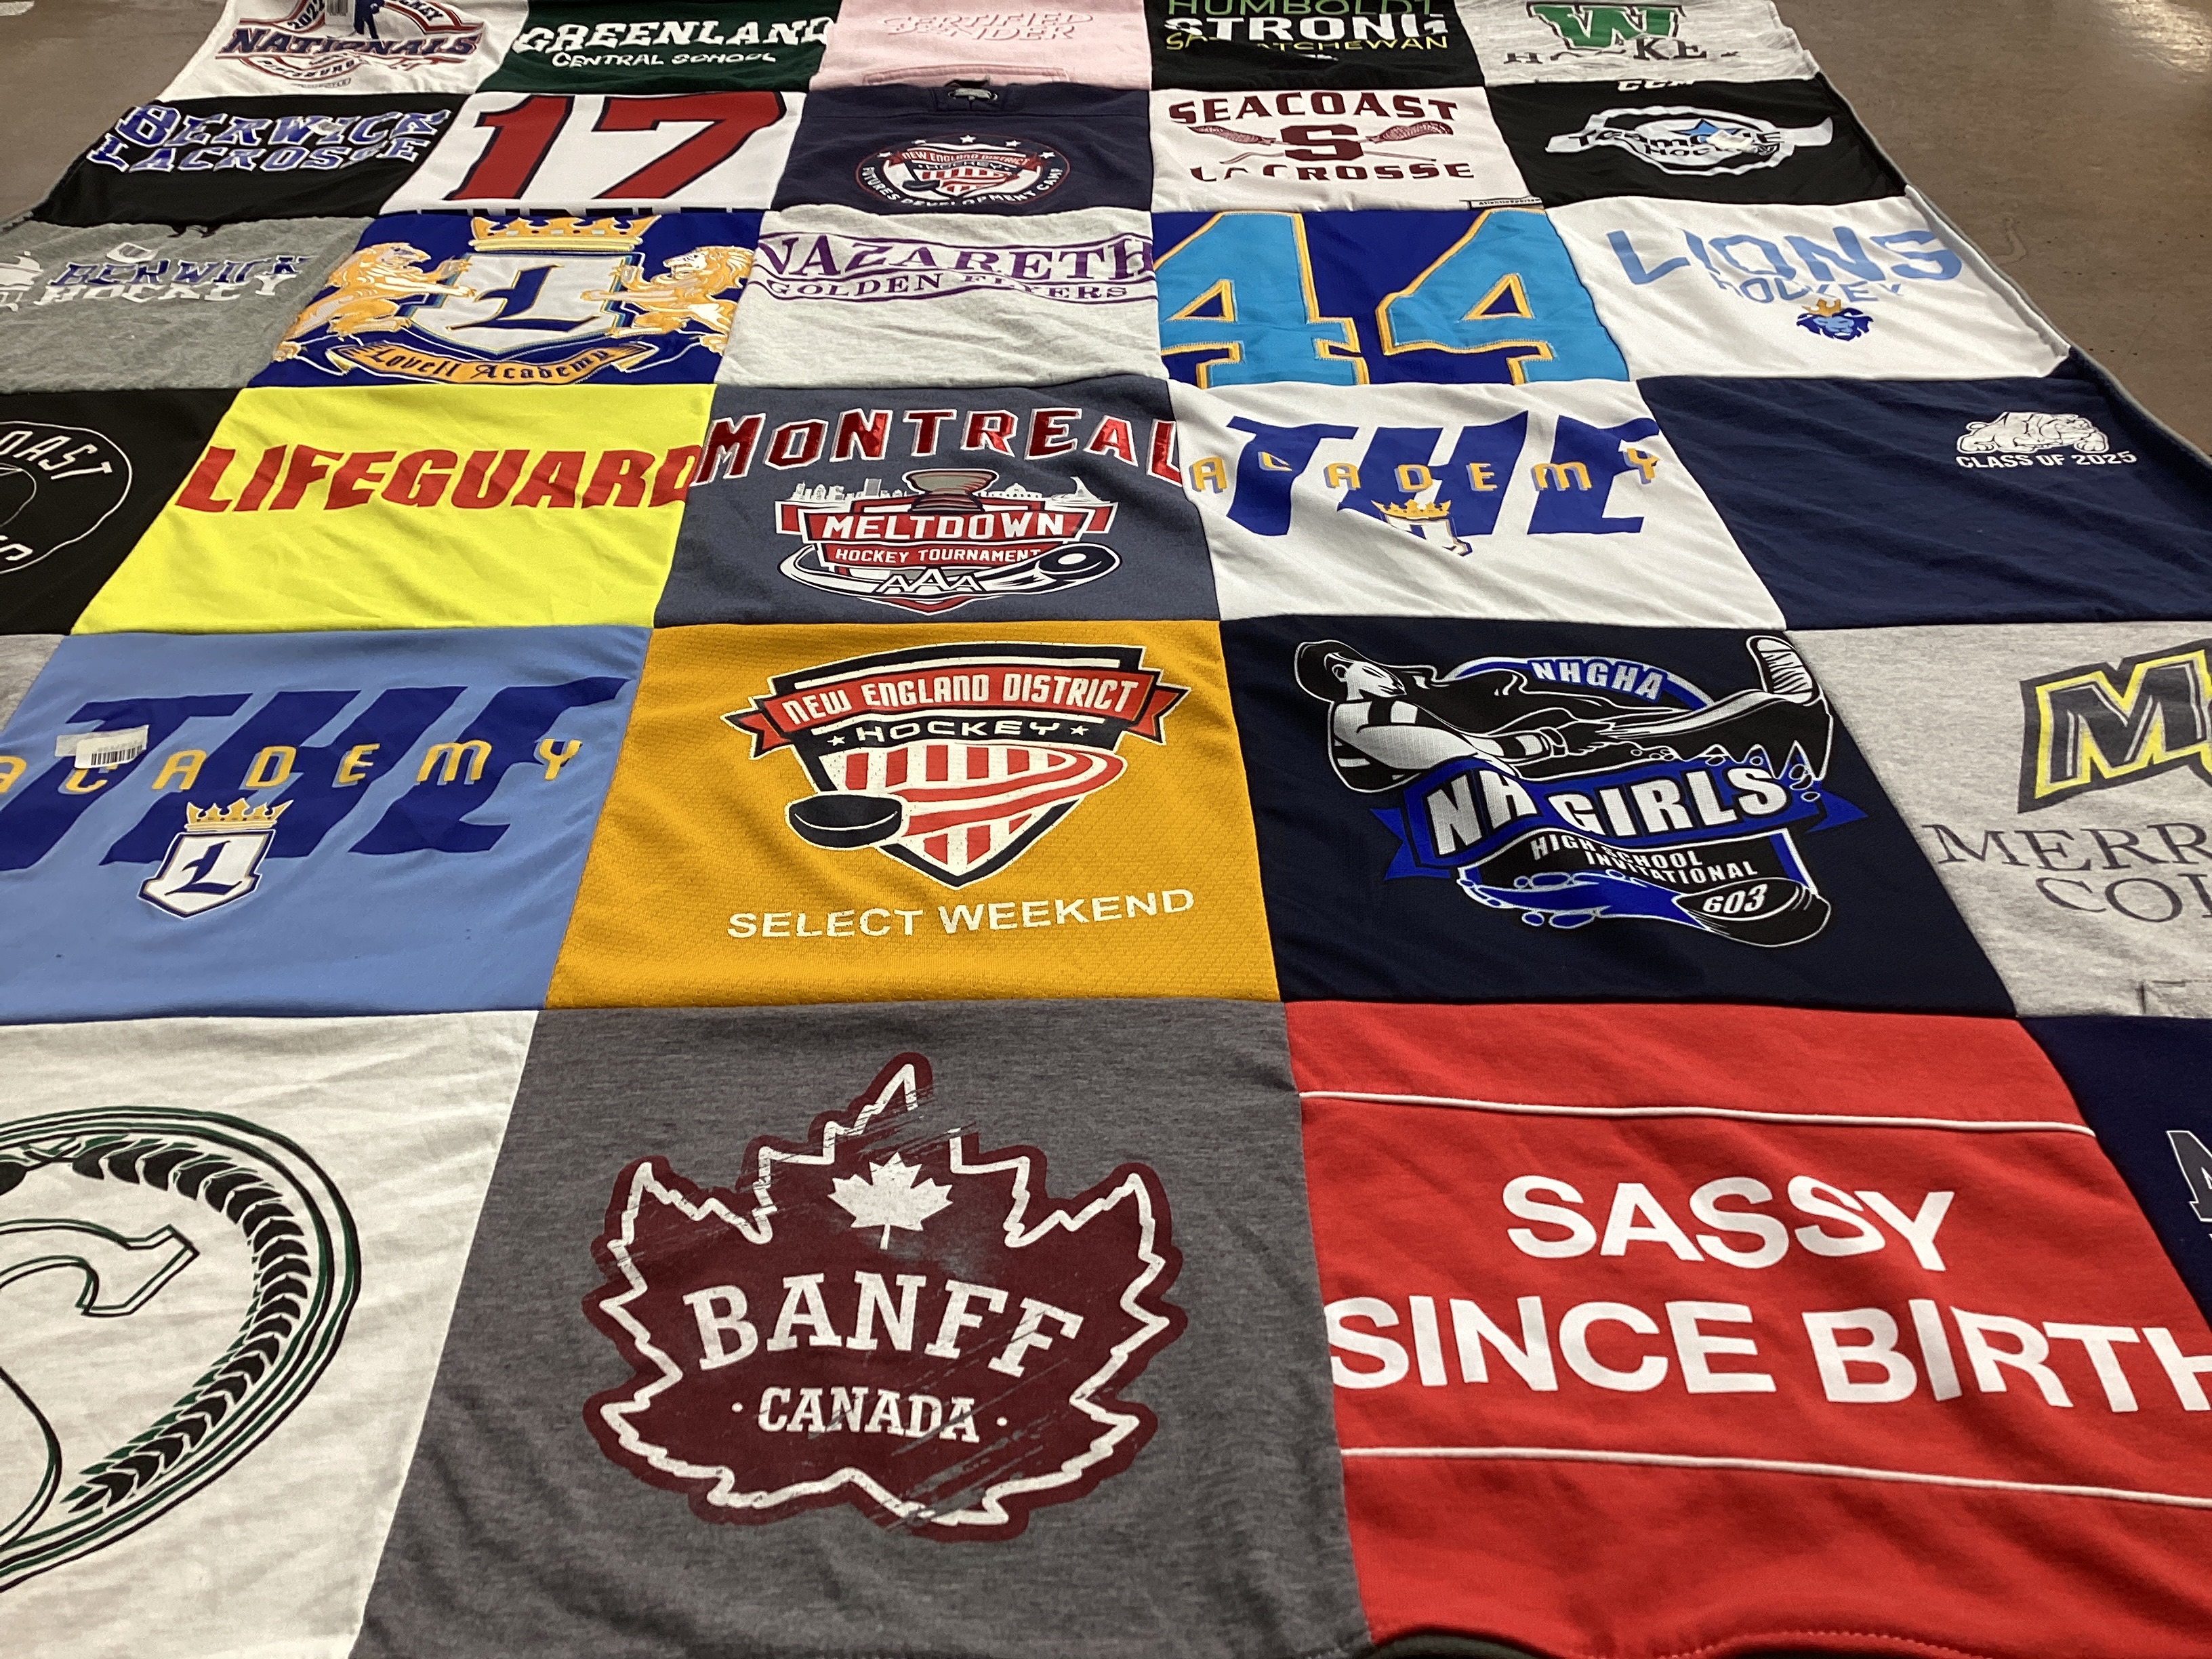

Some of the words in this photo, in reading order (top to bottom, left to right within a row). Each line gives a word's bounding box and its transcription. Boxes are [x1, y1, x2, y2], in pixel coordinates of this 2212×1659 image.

[1168, 0, 1435, 16] HUMBOLDT
[1526, 2, 1687, 50] W
[218, 28, 483, 56] NATIONALS
[512, 17, 834, 54] GREENLAND
[551, 51, 664, 68] CENTRAL
[671, 51, 777, 66] SCHOOL
[115, 104, 452, 147] BERWICK
[1169, 91, 1459, 124] SEACOAST
[441, 90, 787, 201] 17
[901, 151, 927, 161] NEW
[930, 153, 979, 163] ENGLAND
[981, 154, 1031, 166] DISTRICT
[1281, 124, 1365, 161] S
[862, 166, 902, 201] FUTURES
[1036, 167, 1063, 192] CAMP
[47, 254, 319, 286] BERWICK
[758, 234, 1153, 281] NAZARETH
[1605, 226, 1963, 285] LIONS
[33, 274, 298, 305] HOCKEY
[766, 272, 945, 297] GOLDEN
[1153, 207, 1630, 387] 44
[367, 346, 462, 379] Lovell
[470, 348, 614, 380] Academy
[689, 407, 1183, 487] MONTREAL
[1955, 454, 2033, 468] CLASS
[2035, 454, 2066, 466] OF
[2070, 451, 2138, 466] 2025
[175, 444, 703, 512] LIFEGUARD
[821, 513, 1065, 540] MELTDOWN
[835, 548, 910, 564] HOCKEY
[918, 548, 1042, 563] TOURNAMENT
[880, 568, 980, 593] AAA
[1530, 659, 1670, 701] NHGHA
[782, 689, 850, 725] NEW
[861, 674, 991, 713] ENGLAND
[1002, 674, 1140, 713] DISTRICT
[855, 719, 1061, 744] HOCKEY
[1422, 768, 1539, 857] NH
[1548, 766, 1788, 838] GIRLS
[1530, 832, 1597, 861] HIGH
[1601, 844, 1703, 869] SCHOOL
[1585, 850, 1759, 885] INVITATIONAL
[726, 907, 926, 939] SELECT
[938, 888, 1196, 936] WEEKEND
[1702, 883, 1769, 915] 603
[1502, 1174, 1955, 1271] SASSY
[682, 1270, 1084, 1377] BANFF
[1323, 1295, 1777, 1395] SINCE
[1802, 1298, 2212, 1414] BIRTH
[757, 1387, 981, 1443] CANADA
